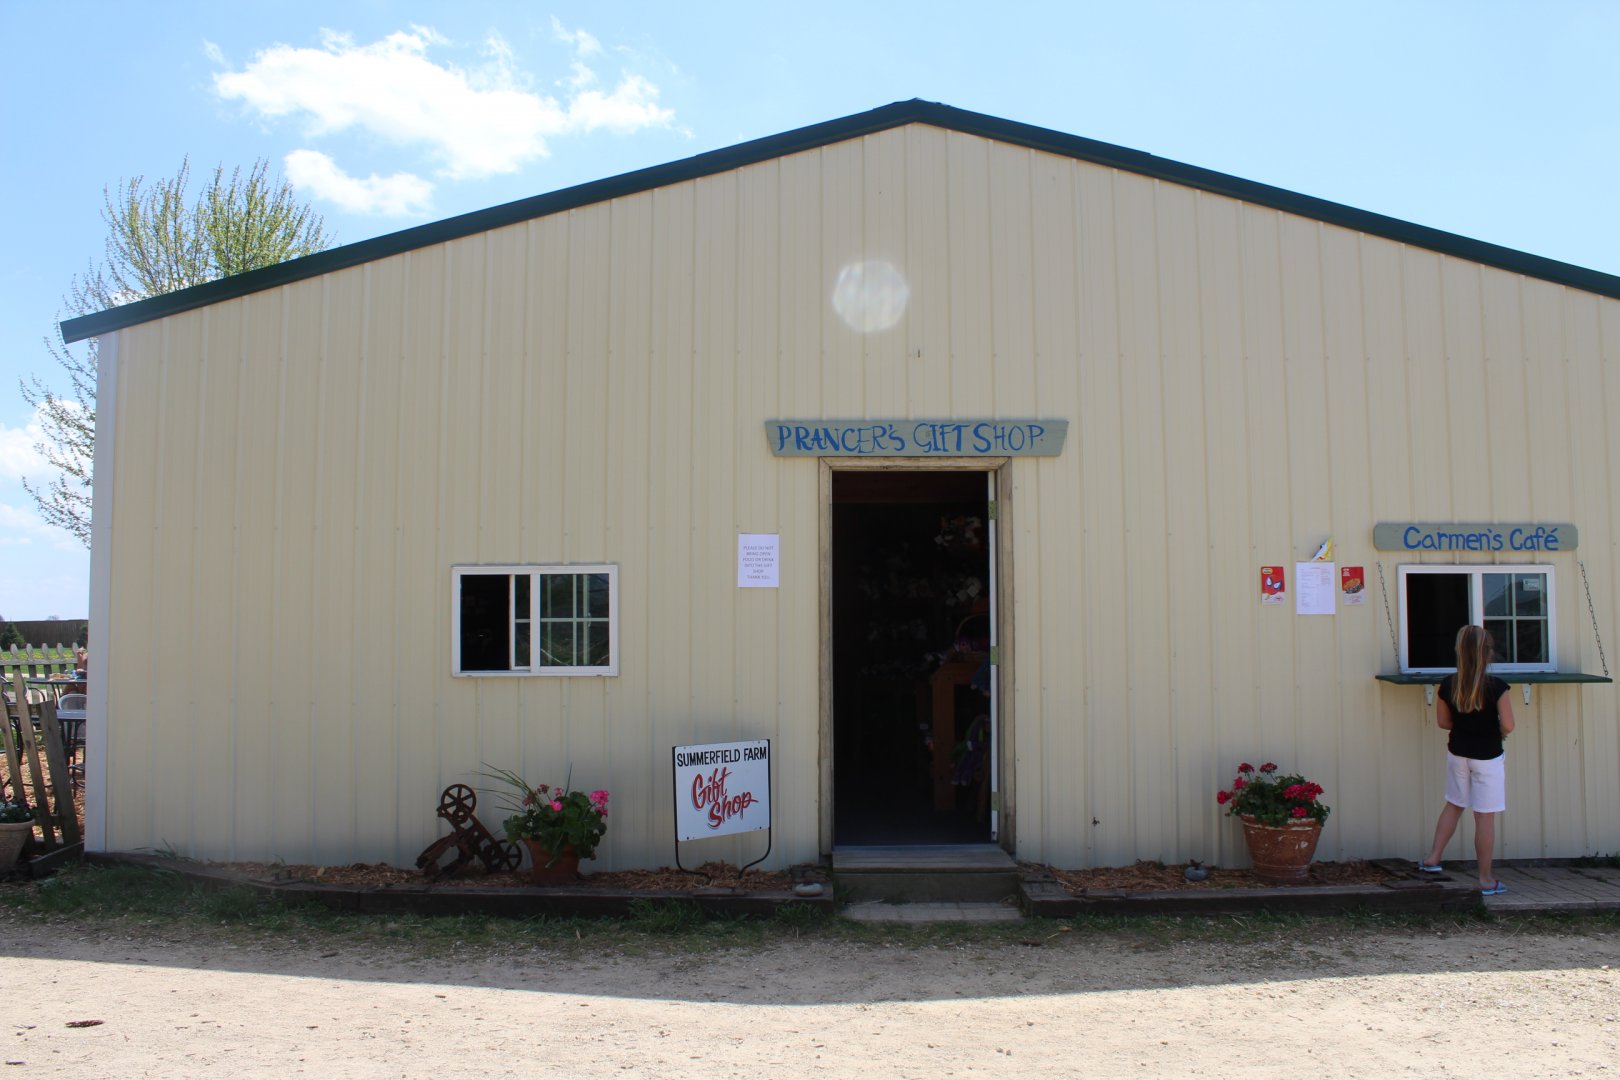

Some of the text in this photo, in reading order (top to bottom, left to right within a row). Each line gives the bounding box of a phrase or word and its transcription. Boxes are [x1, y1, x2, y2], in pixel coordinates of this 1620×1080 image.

[777, 422, 1045, 454] PRANCER'S GIFT SHOP
[1403, 526, 1559, 551] Carmen's Café
[677, 747, 767, 767] SUMMERFIELD FARM
[692, 767, 732, 811] Gift
[708, 792, 758, 829] Shop
